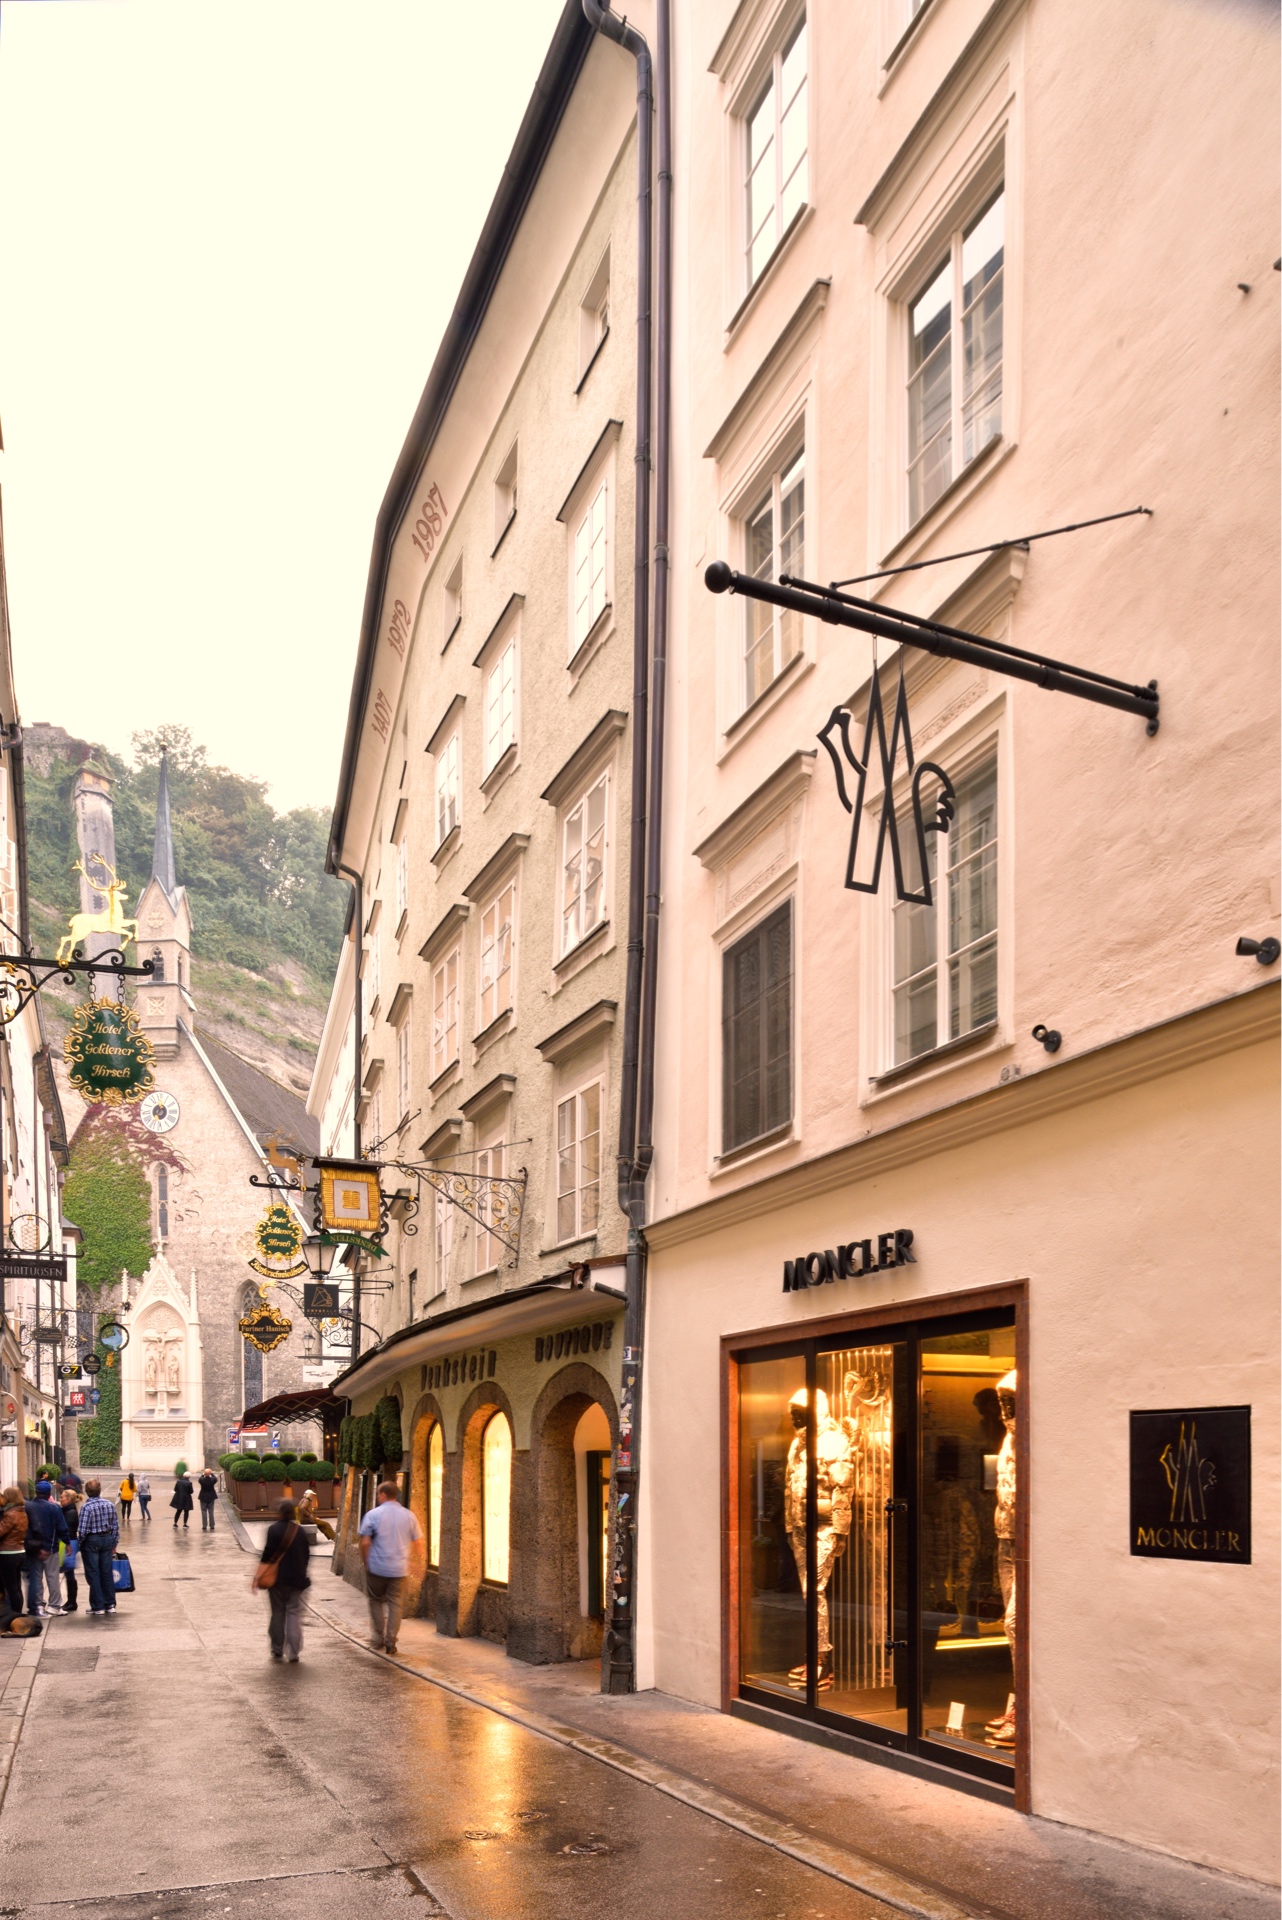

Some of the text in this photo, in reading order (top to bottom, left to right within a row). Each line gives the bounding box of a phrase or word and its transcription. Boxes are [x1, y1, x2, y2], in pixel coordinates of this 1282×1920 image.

[412, 481, 449, 563] 1987
[387, 599, 412, 663] 1972
[371, 688, 393, 745] 1407
[91, 1022, 125, 1035] Hotel
[85, 1043, 135, 1056] Goldener
[91, 1064, 131, 1078] Hirsch
[267, 1239, 291, 1247] Hirsch
[330, 1235, 378, 1252] DENKSTEIN
[782, 1228, 918, 1293] MONCLER
[420, 1320, 615, 1392] Denkstein BOUTIQUE
[61, 1366, 79, 1374] G7
[1136, 1526, 1243, 1552] MONCLER
